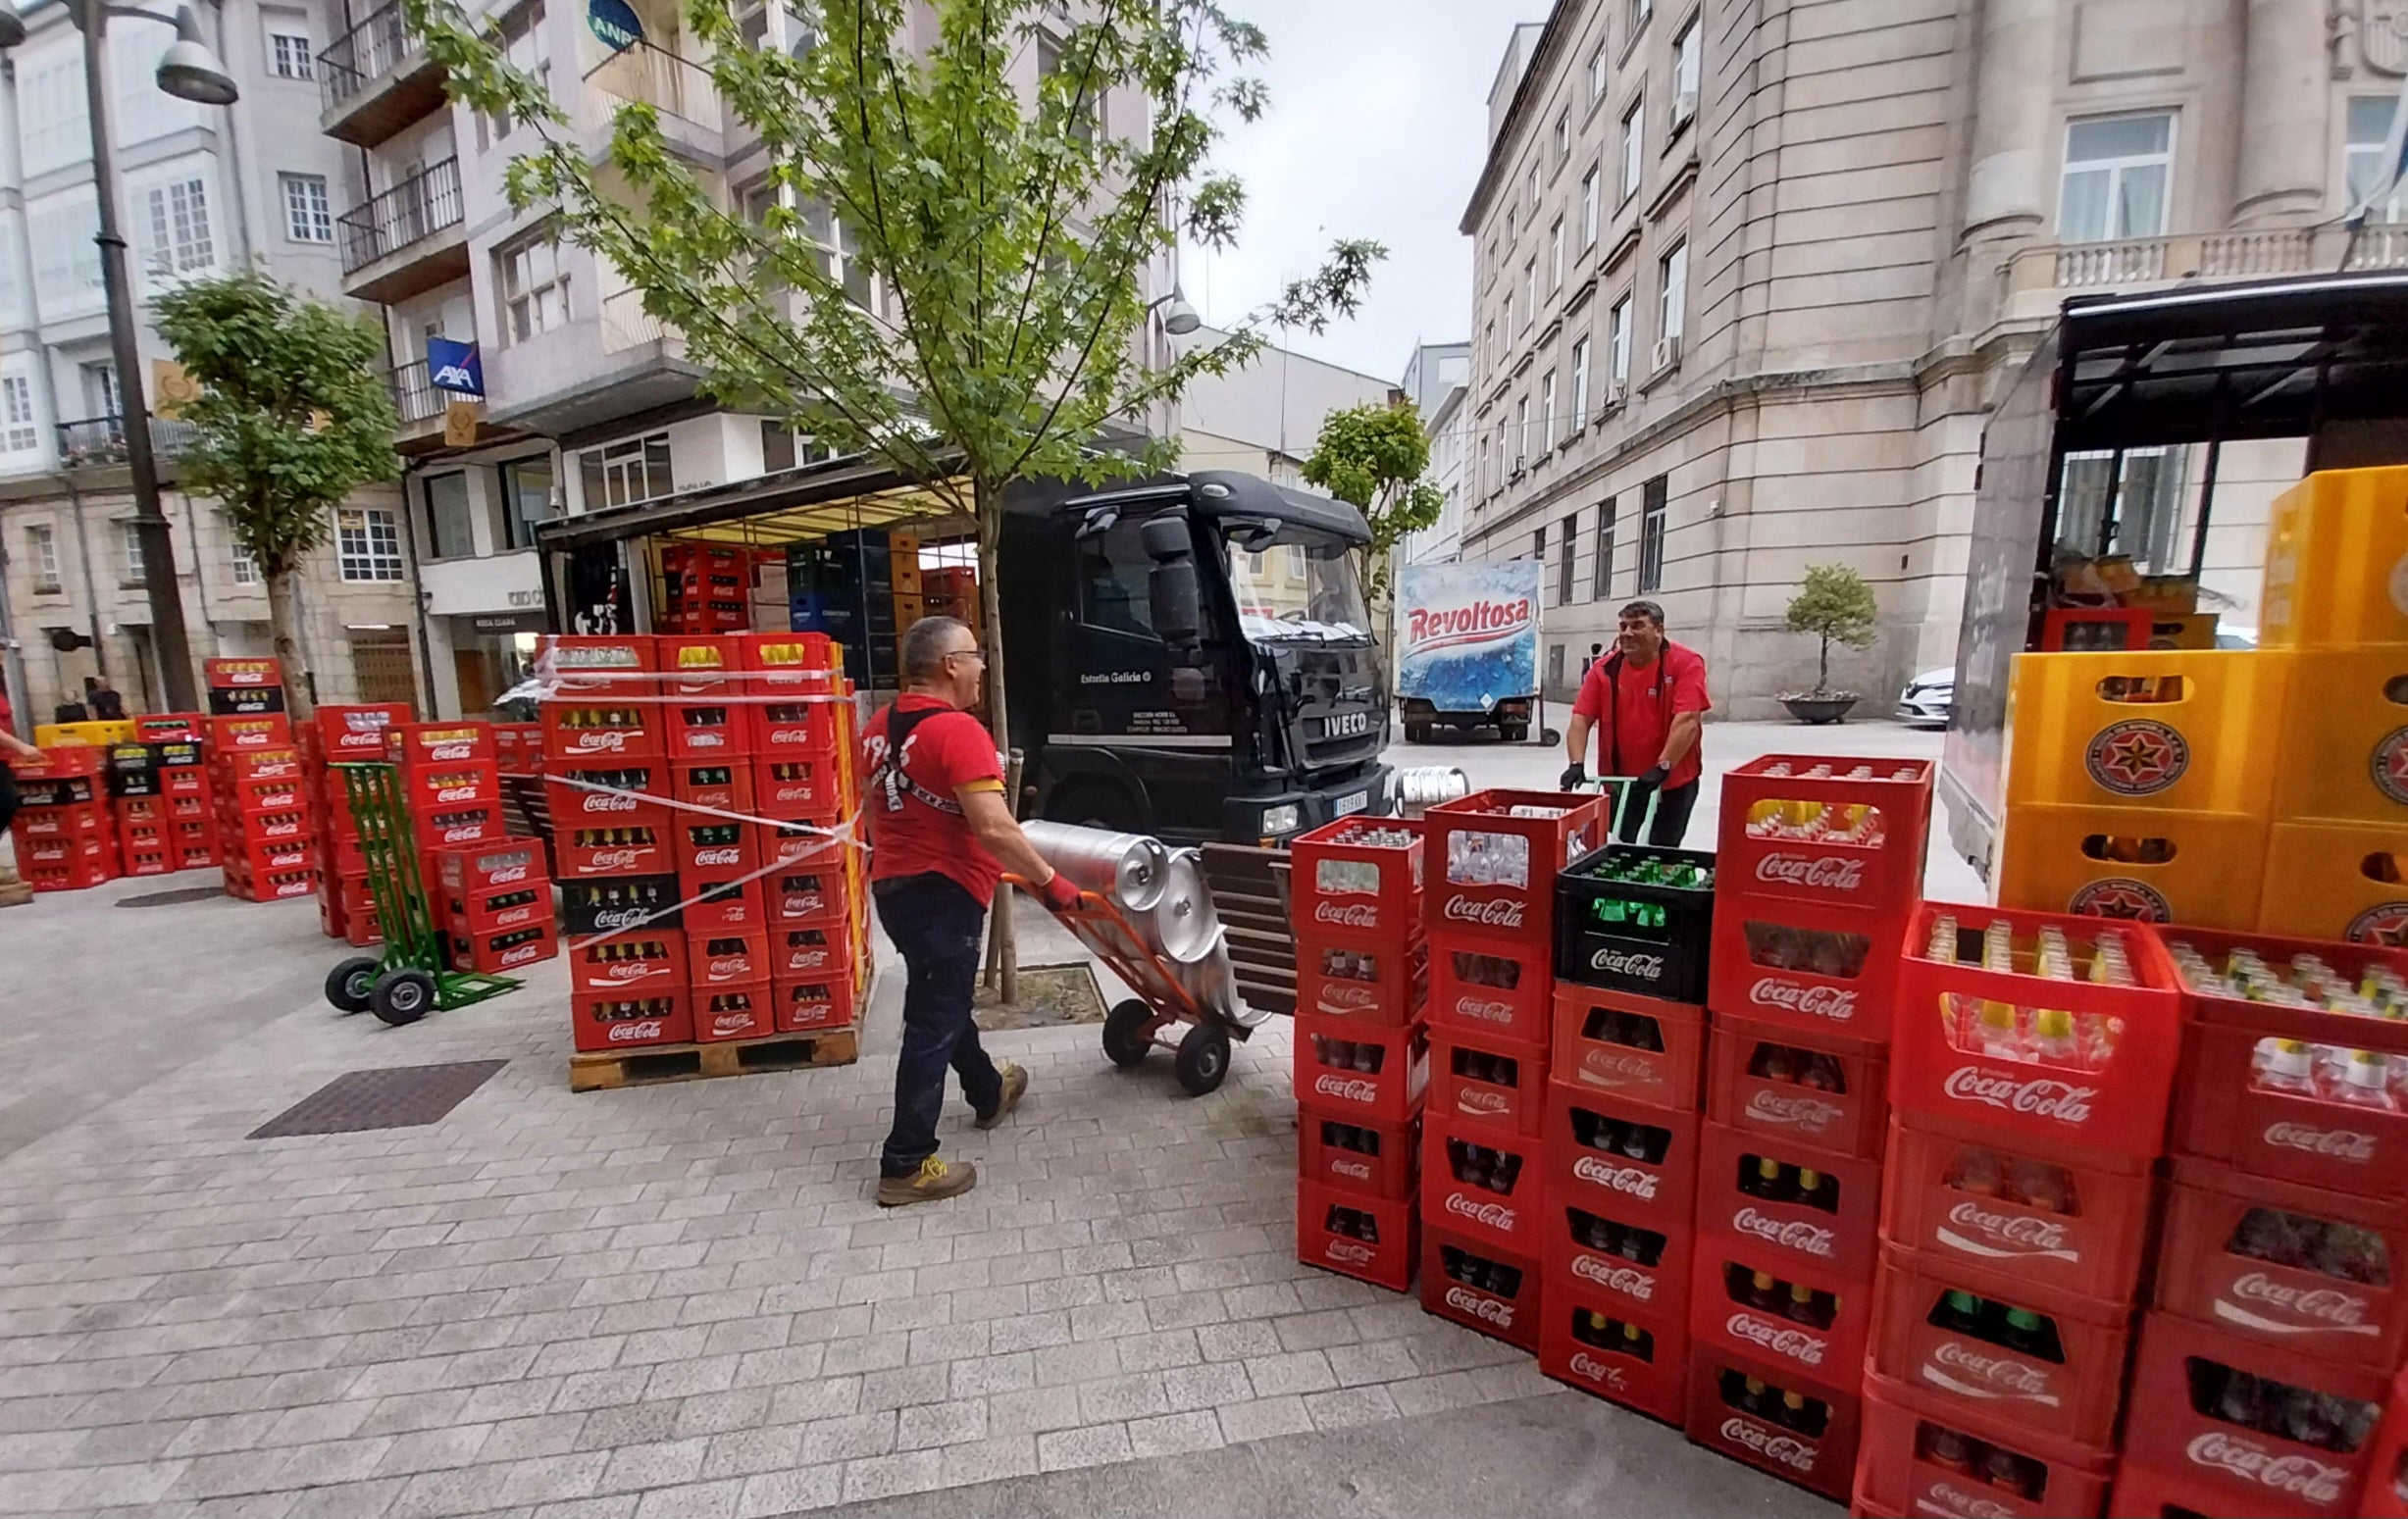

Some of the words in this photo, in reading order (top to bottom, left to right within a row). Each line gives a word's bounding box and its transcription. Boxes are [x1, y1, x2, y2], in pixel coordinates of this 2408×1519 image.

[433, 365, 475, 388] AXA
[1409, 598, 1529, 644] Revoltosa
[1081, 674, 1109, 684] Estrella
[1111, 672, 1141, 683] Galicia
[1324, 712, 1366, 738] IVECO
